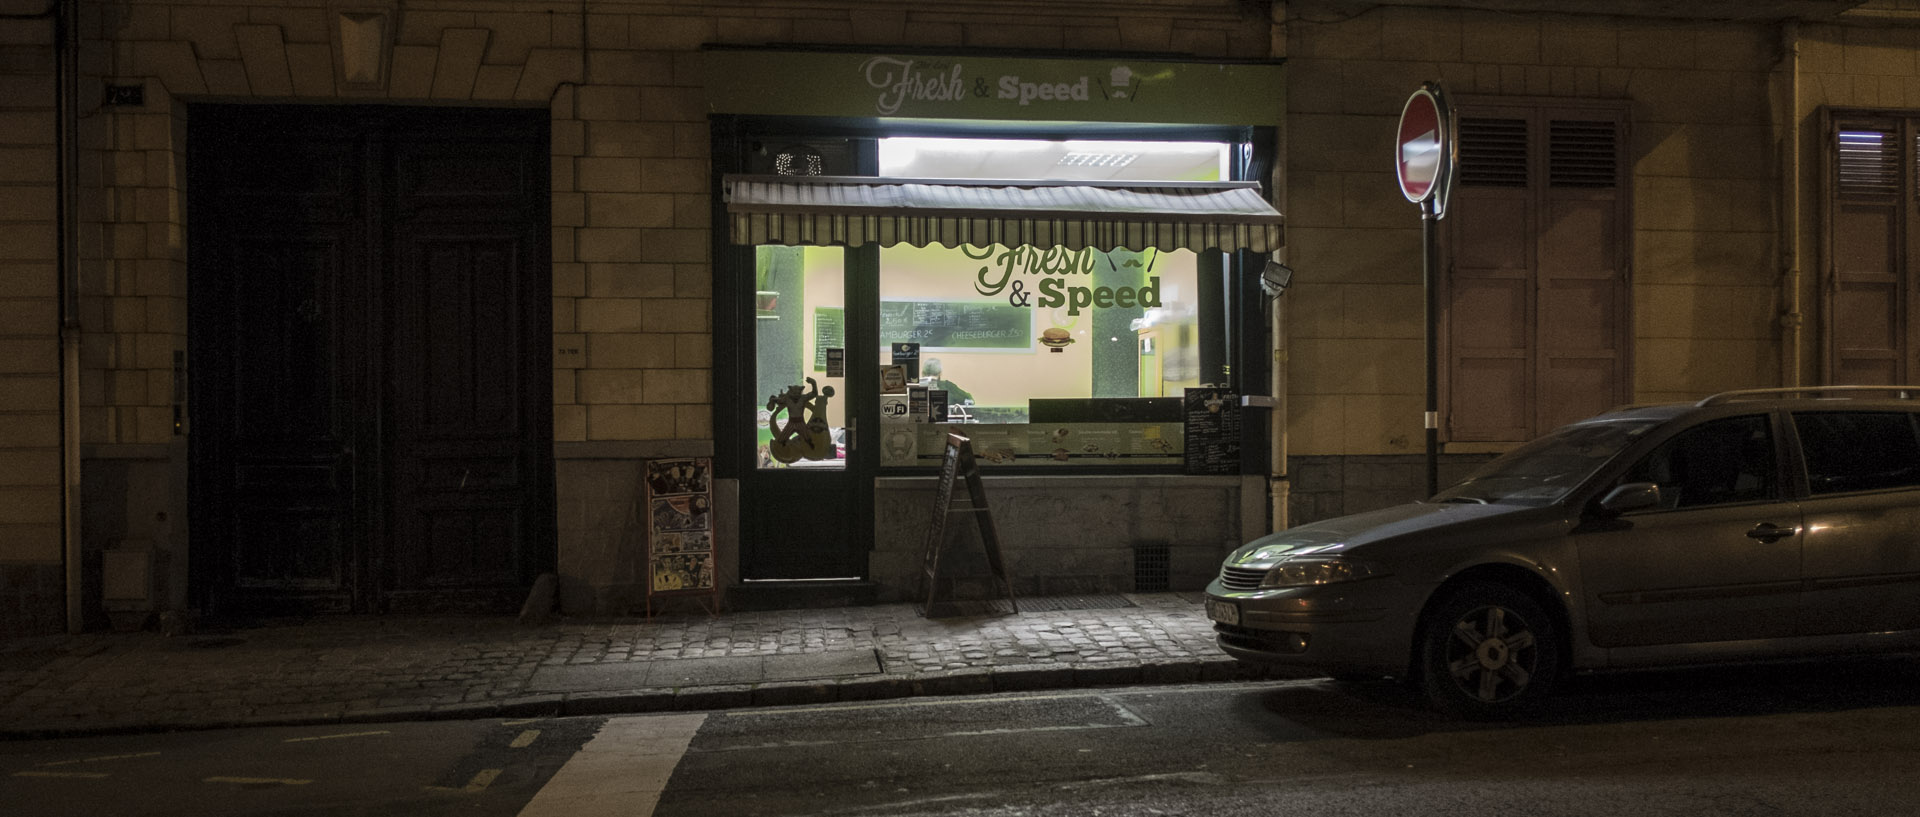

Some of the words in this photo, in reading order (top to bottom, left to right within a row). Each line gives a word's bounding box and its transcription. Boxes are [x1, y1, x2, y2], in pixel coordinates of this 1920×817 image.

[858, 56, 965, 115] Fresh
[973, 77, 990, 98] &
[997, 75, 1089, 105] Speed
[1009, 279, 1031, 308] &
[1038, 276, 1162, 317] Speed
[880, 329, 922, 339] AMBURGER
